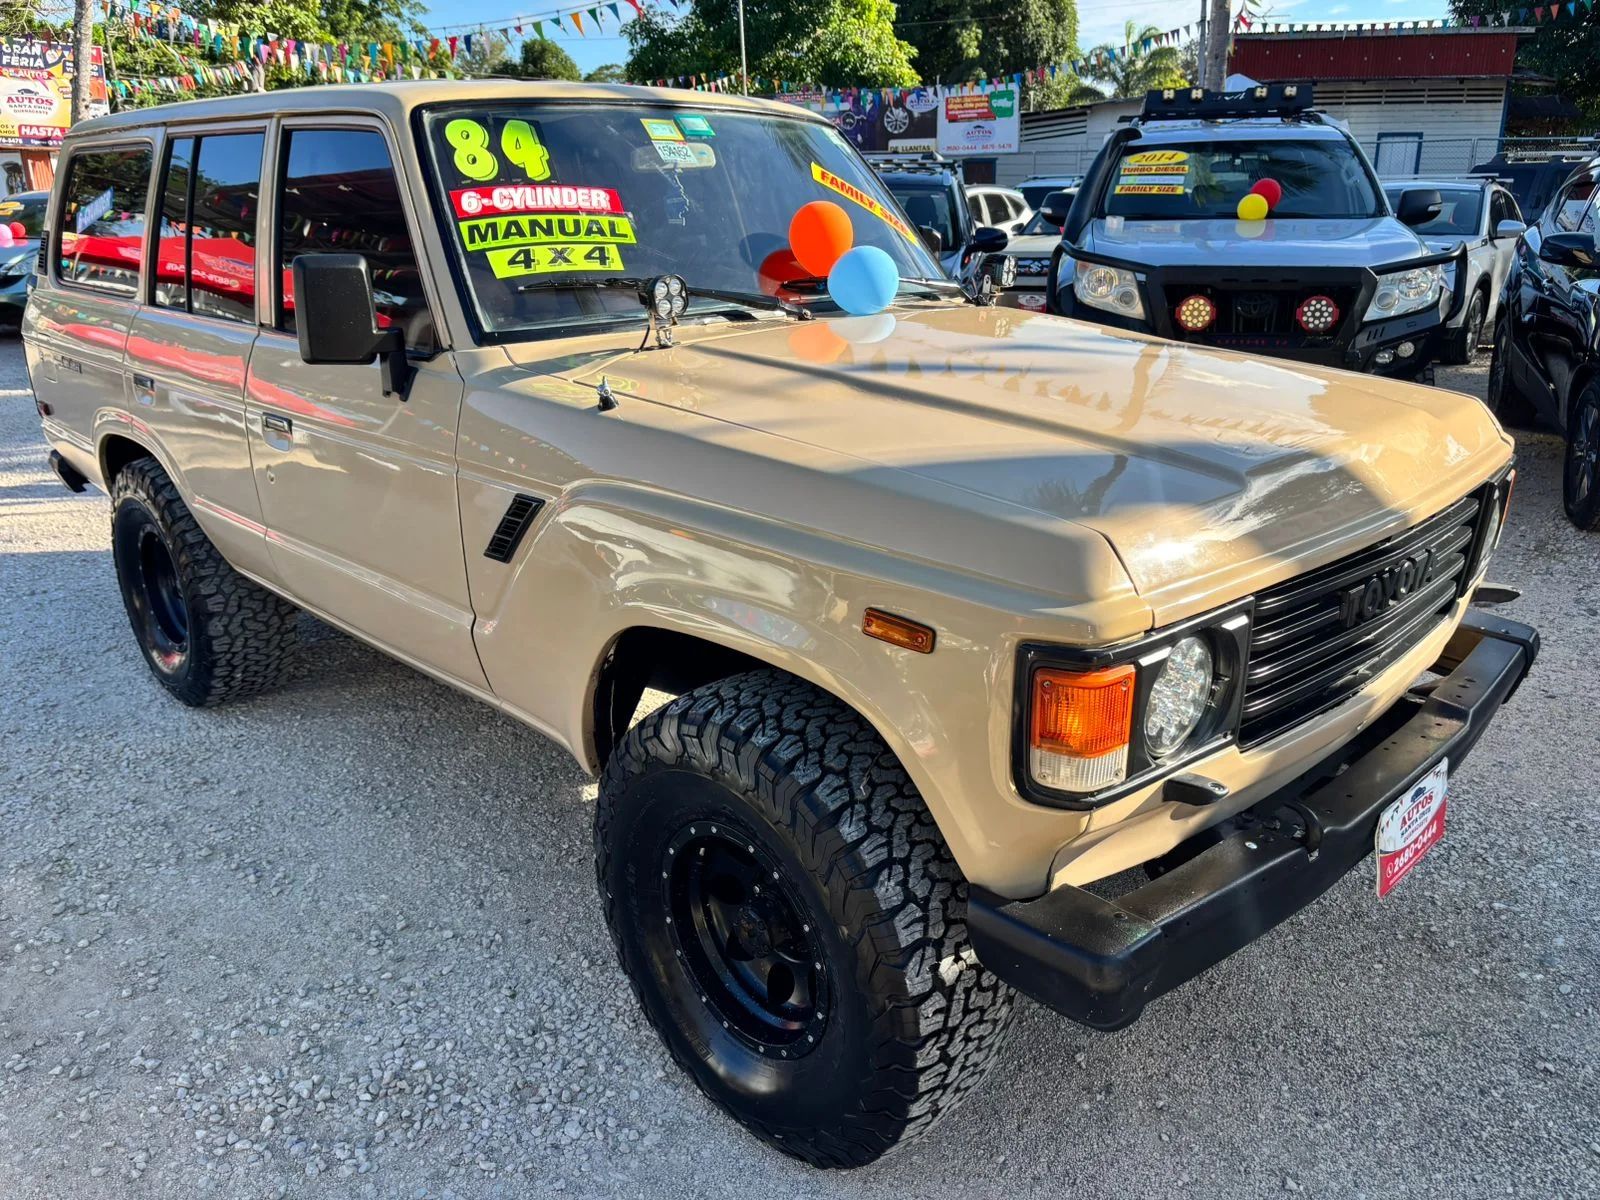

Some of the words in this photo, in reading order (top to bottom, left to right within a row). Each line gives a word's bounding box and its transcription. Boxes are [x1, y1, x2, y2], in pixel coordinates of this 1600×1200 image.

[2, 43, 41, 56] GRAN
[2, 55, 45, 68] FERIA
[18, 69, 49, 79] AUTOS
[6, 96, 53, 106] AUTOS
[21, 126, 63, 138] HASTA
[445, 119, 550, 181] 84
[1134, 152, 1179, 163] 2014
[461, 187, 612, 213] 6-CYLINDER
[820, 170, 875, 209] FAMILY
[879, 206, 909, 235] SIZE
[467, 217, 630, 246] MANUAL
[1342, 547, 1438, 628] TOYOTA
[1400, 791, 1434, 831] AUTOS
[1393, 820, 1438, 874] 2680-0444
